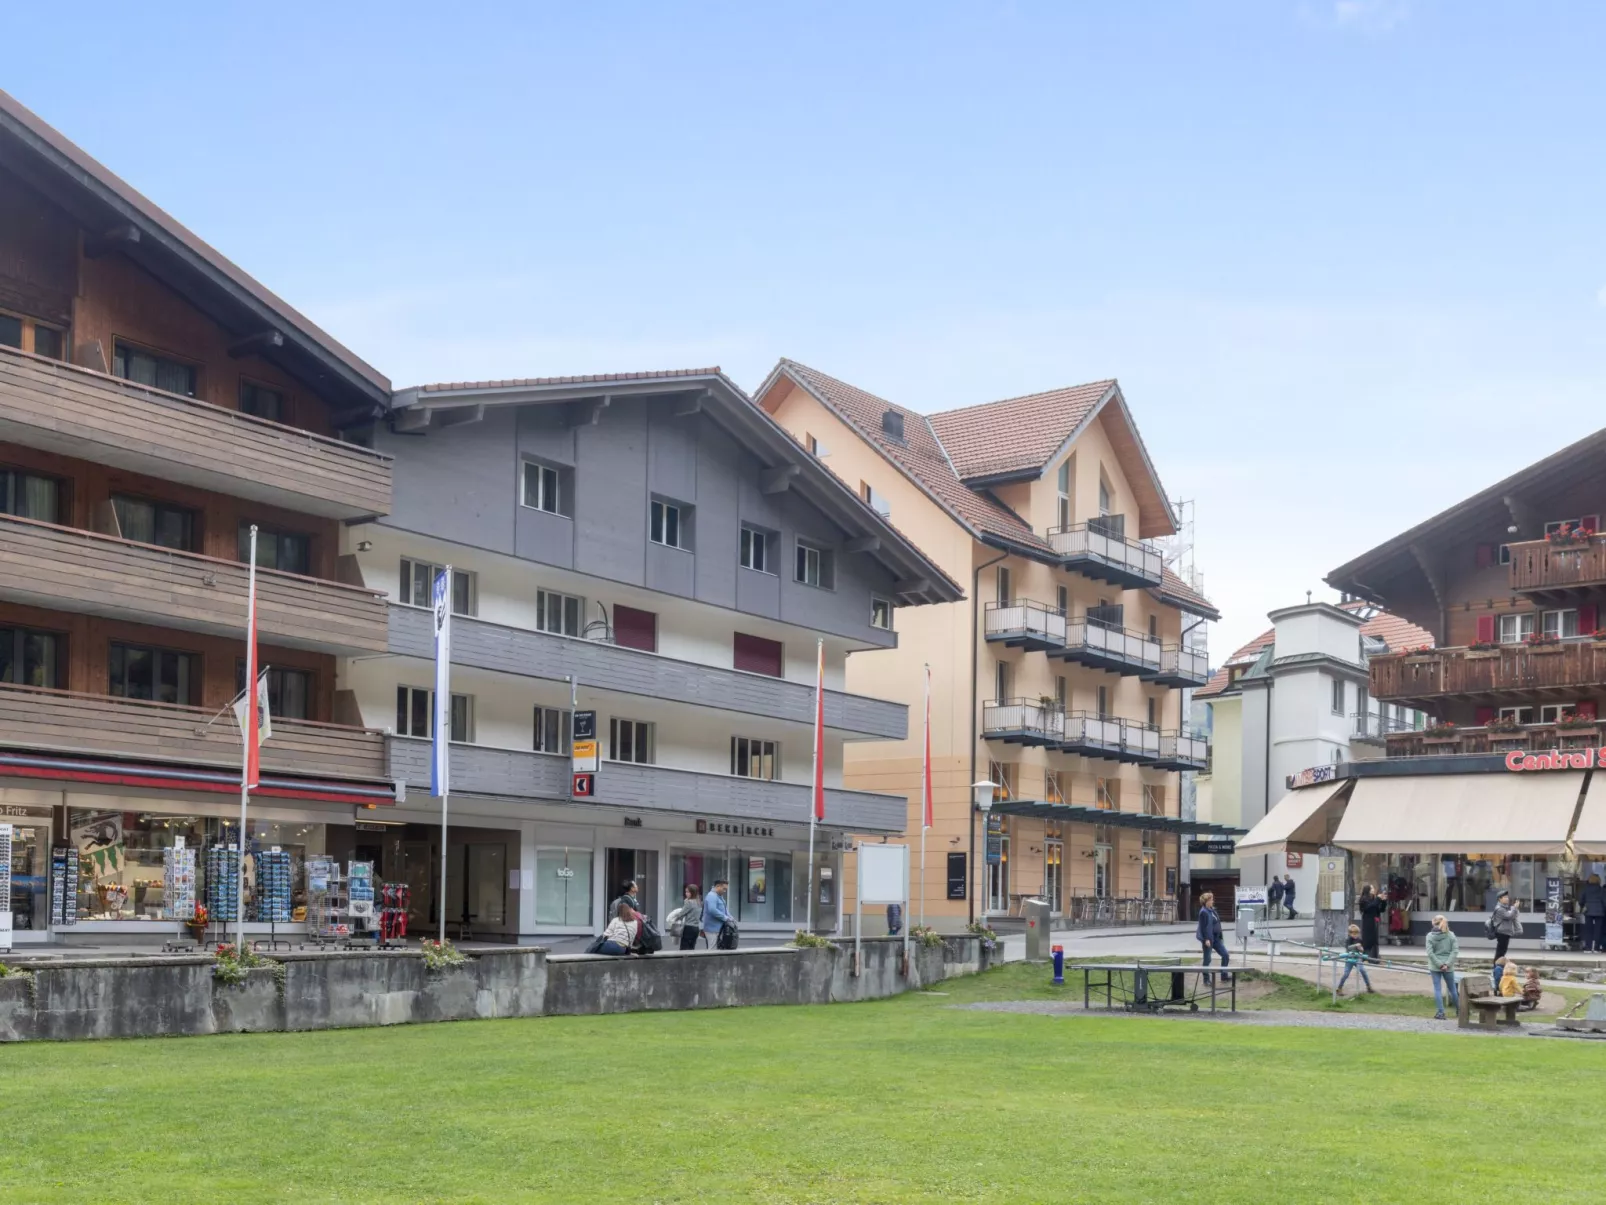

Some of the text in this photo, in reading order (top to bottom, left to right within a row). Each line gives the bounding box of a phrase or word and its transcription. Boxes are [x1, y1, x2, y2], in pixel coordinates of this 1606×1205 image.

[1505, 747, 1594, 772] Central
[6, 805, 28, 817] Fritz
[1549, 880, 1560, 910] SALE
